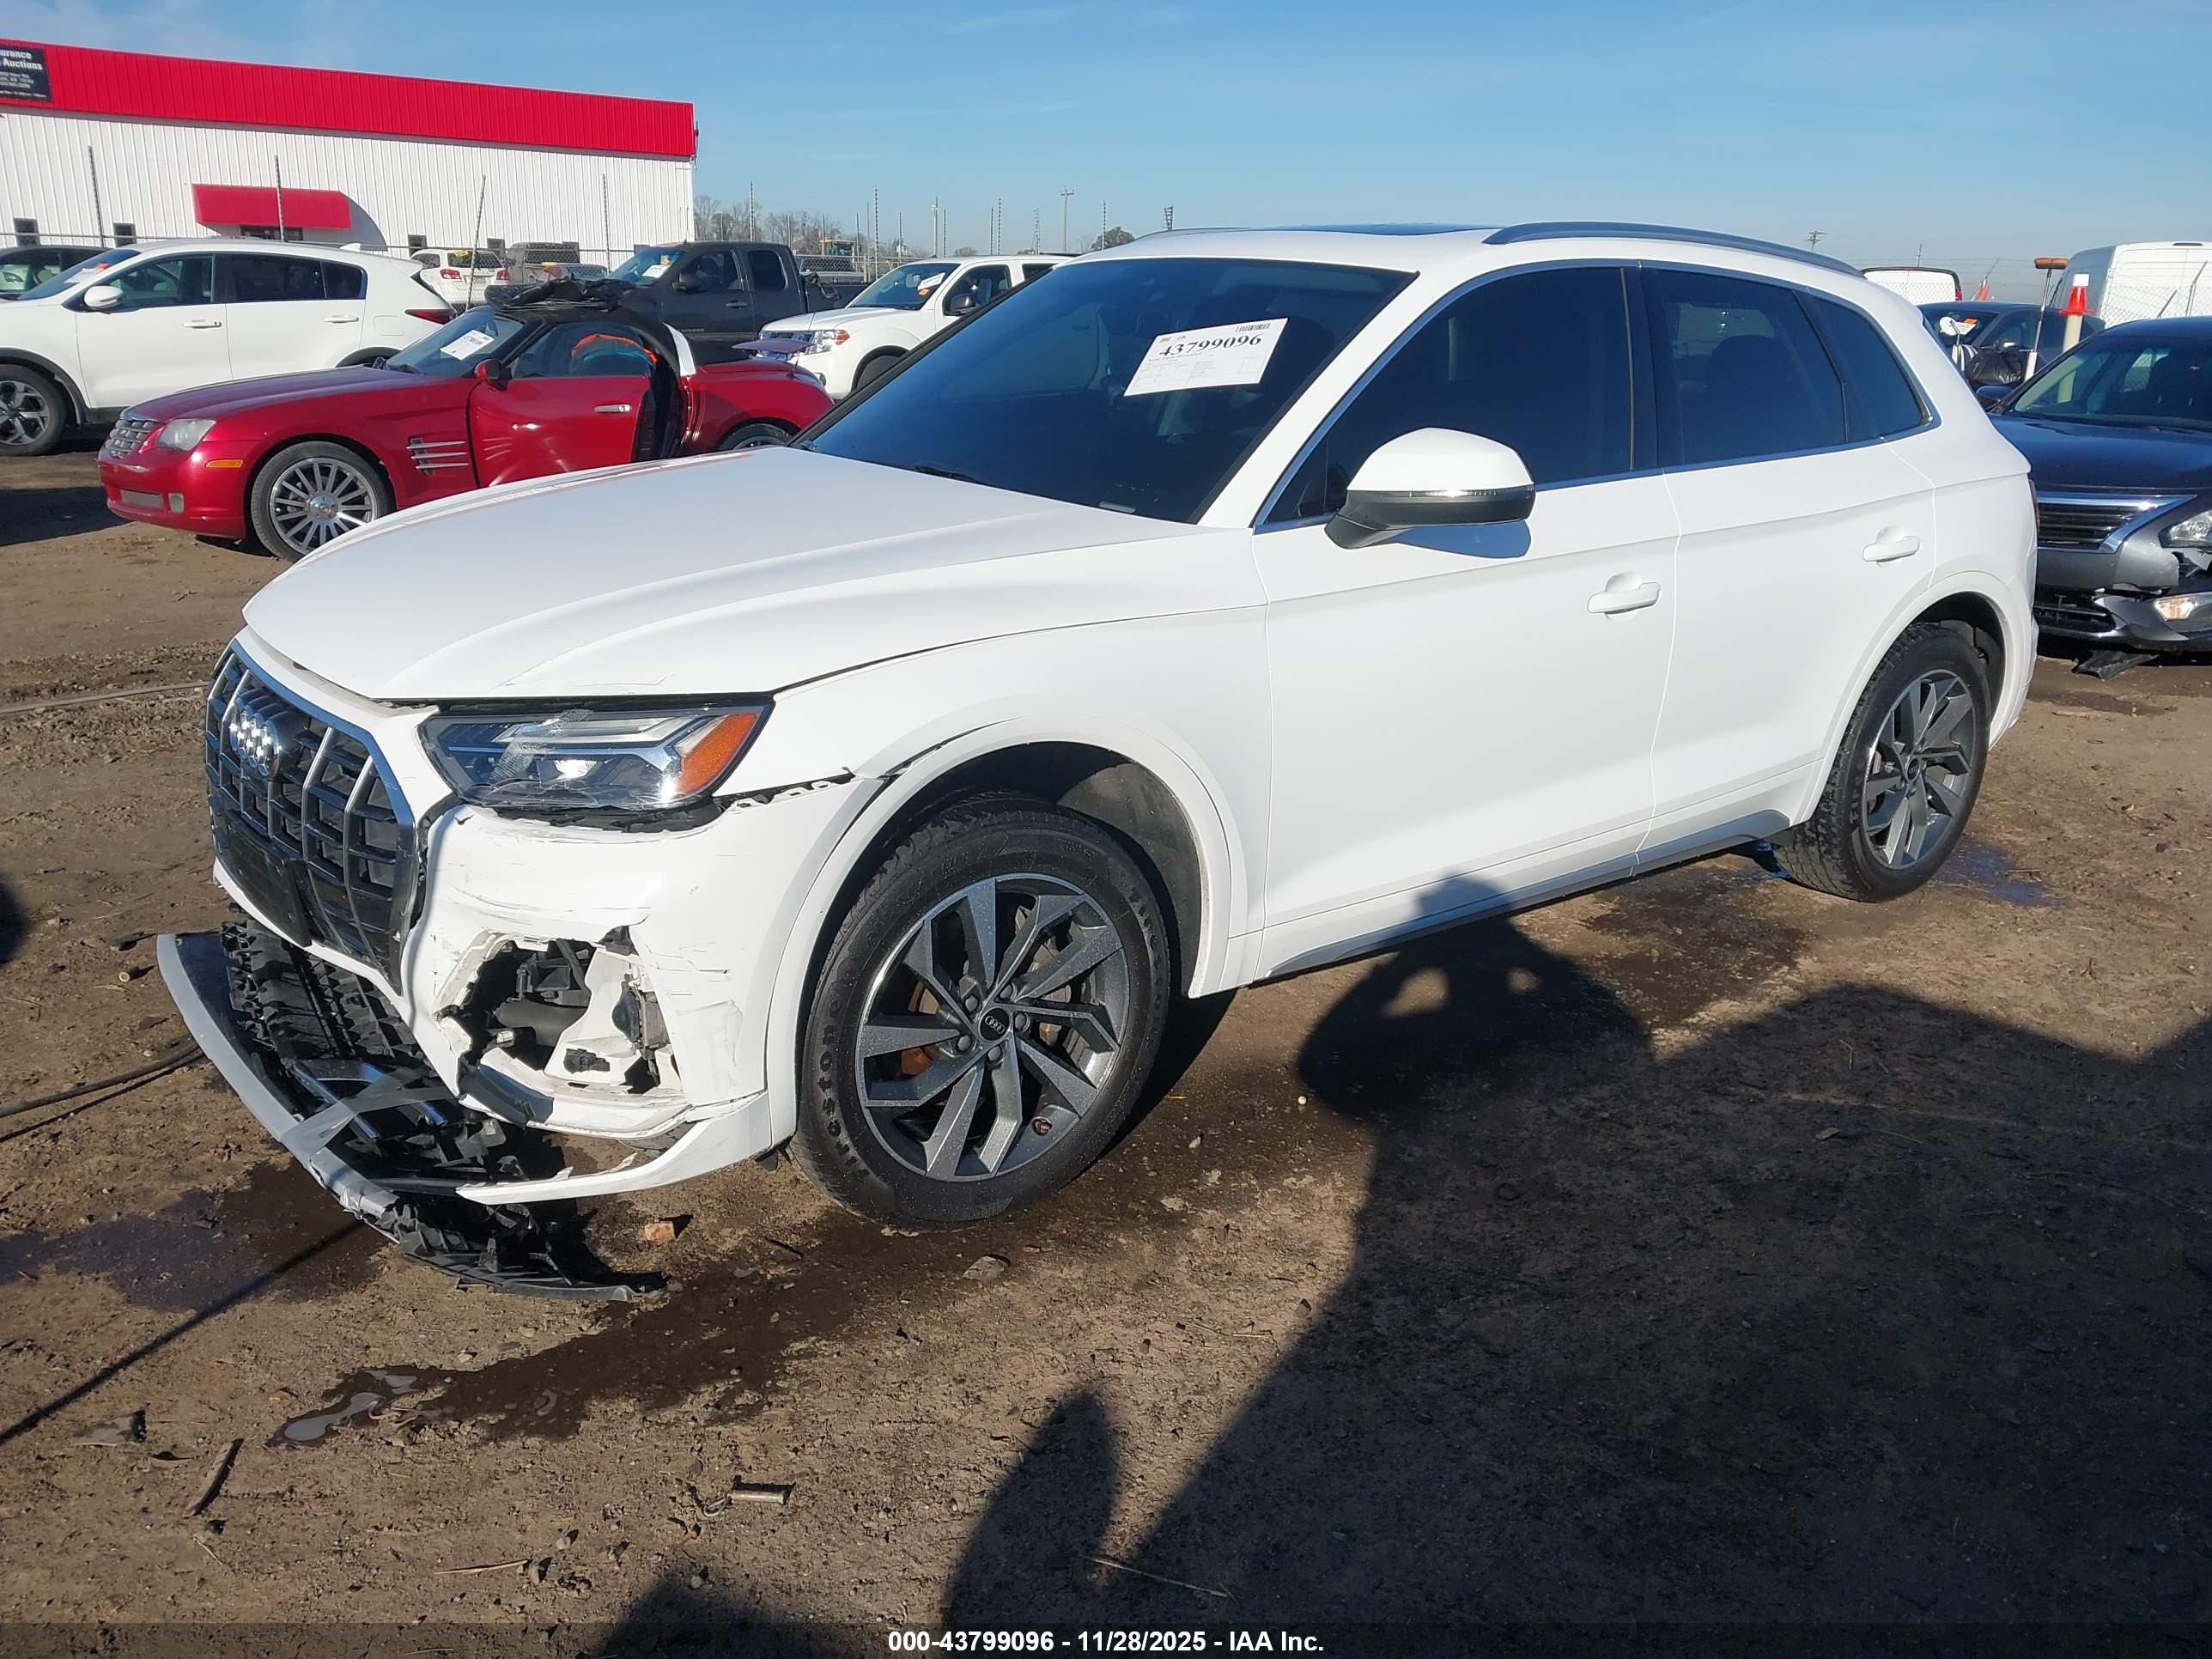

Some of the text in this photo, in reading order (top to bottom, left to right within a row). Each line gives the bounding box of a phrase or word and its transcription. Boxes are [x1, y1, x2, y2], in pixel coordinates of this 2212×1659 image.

[0, 49, 32, 59] urance
[3, 58, 43, 70] Auctions
[1159, 333, 1264, 356] 43799096
